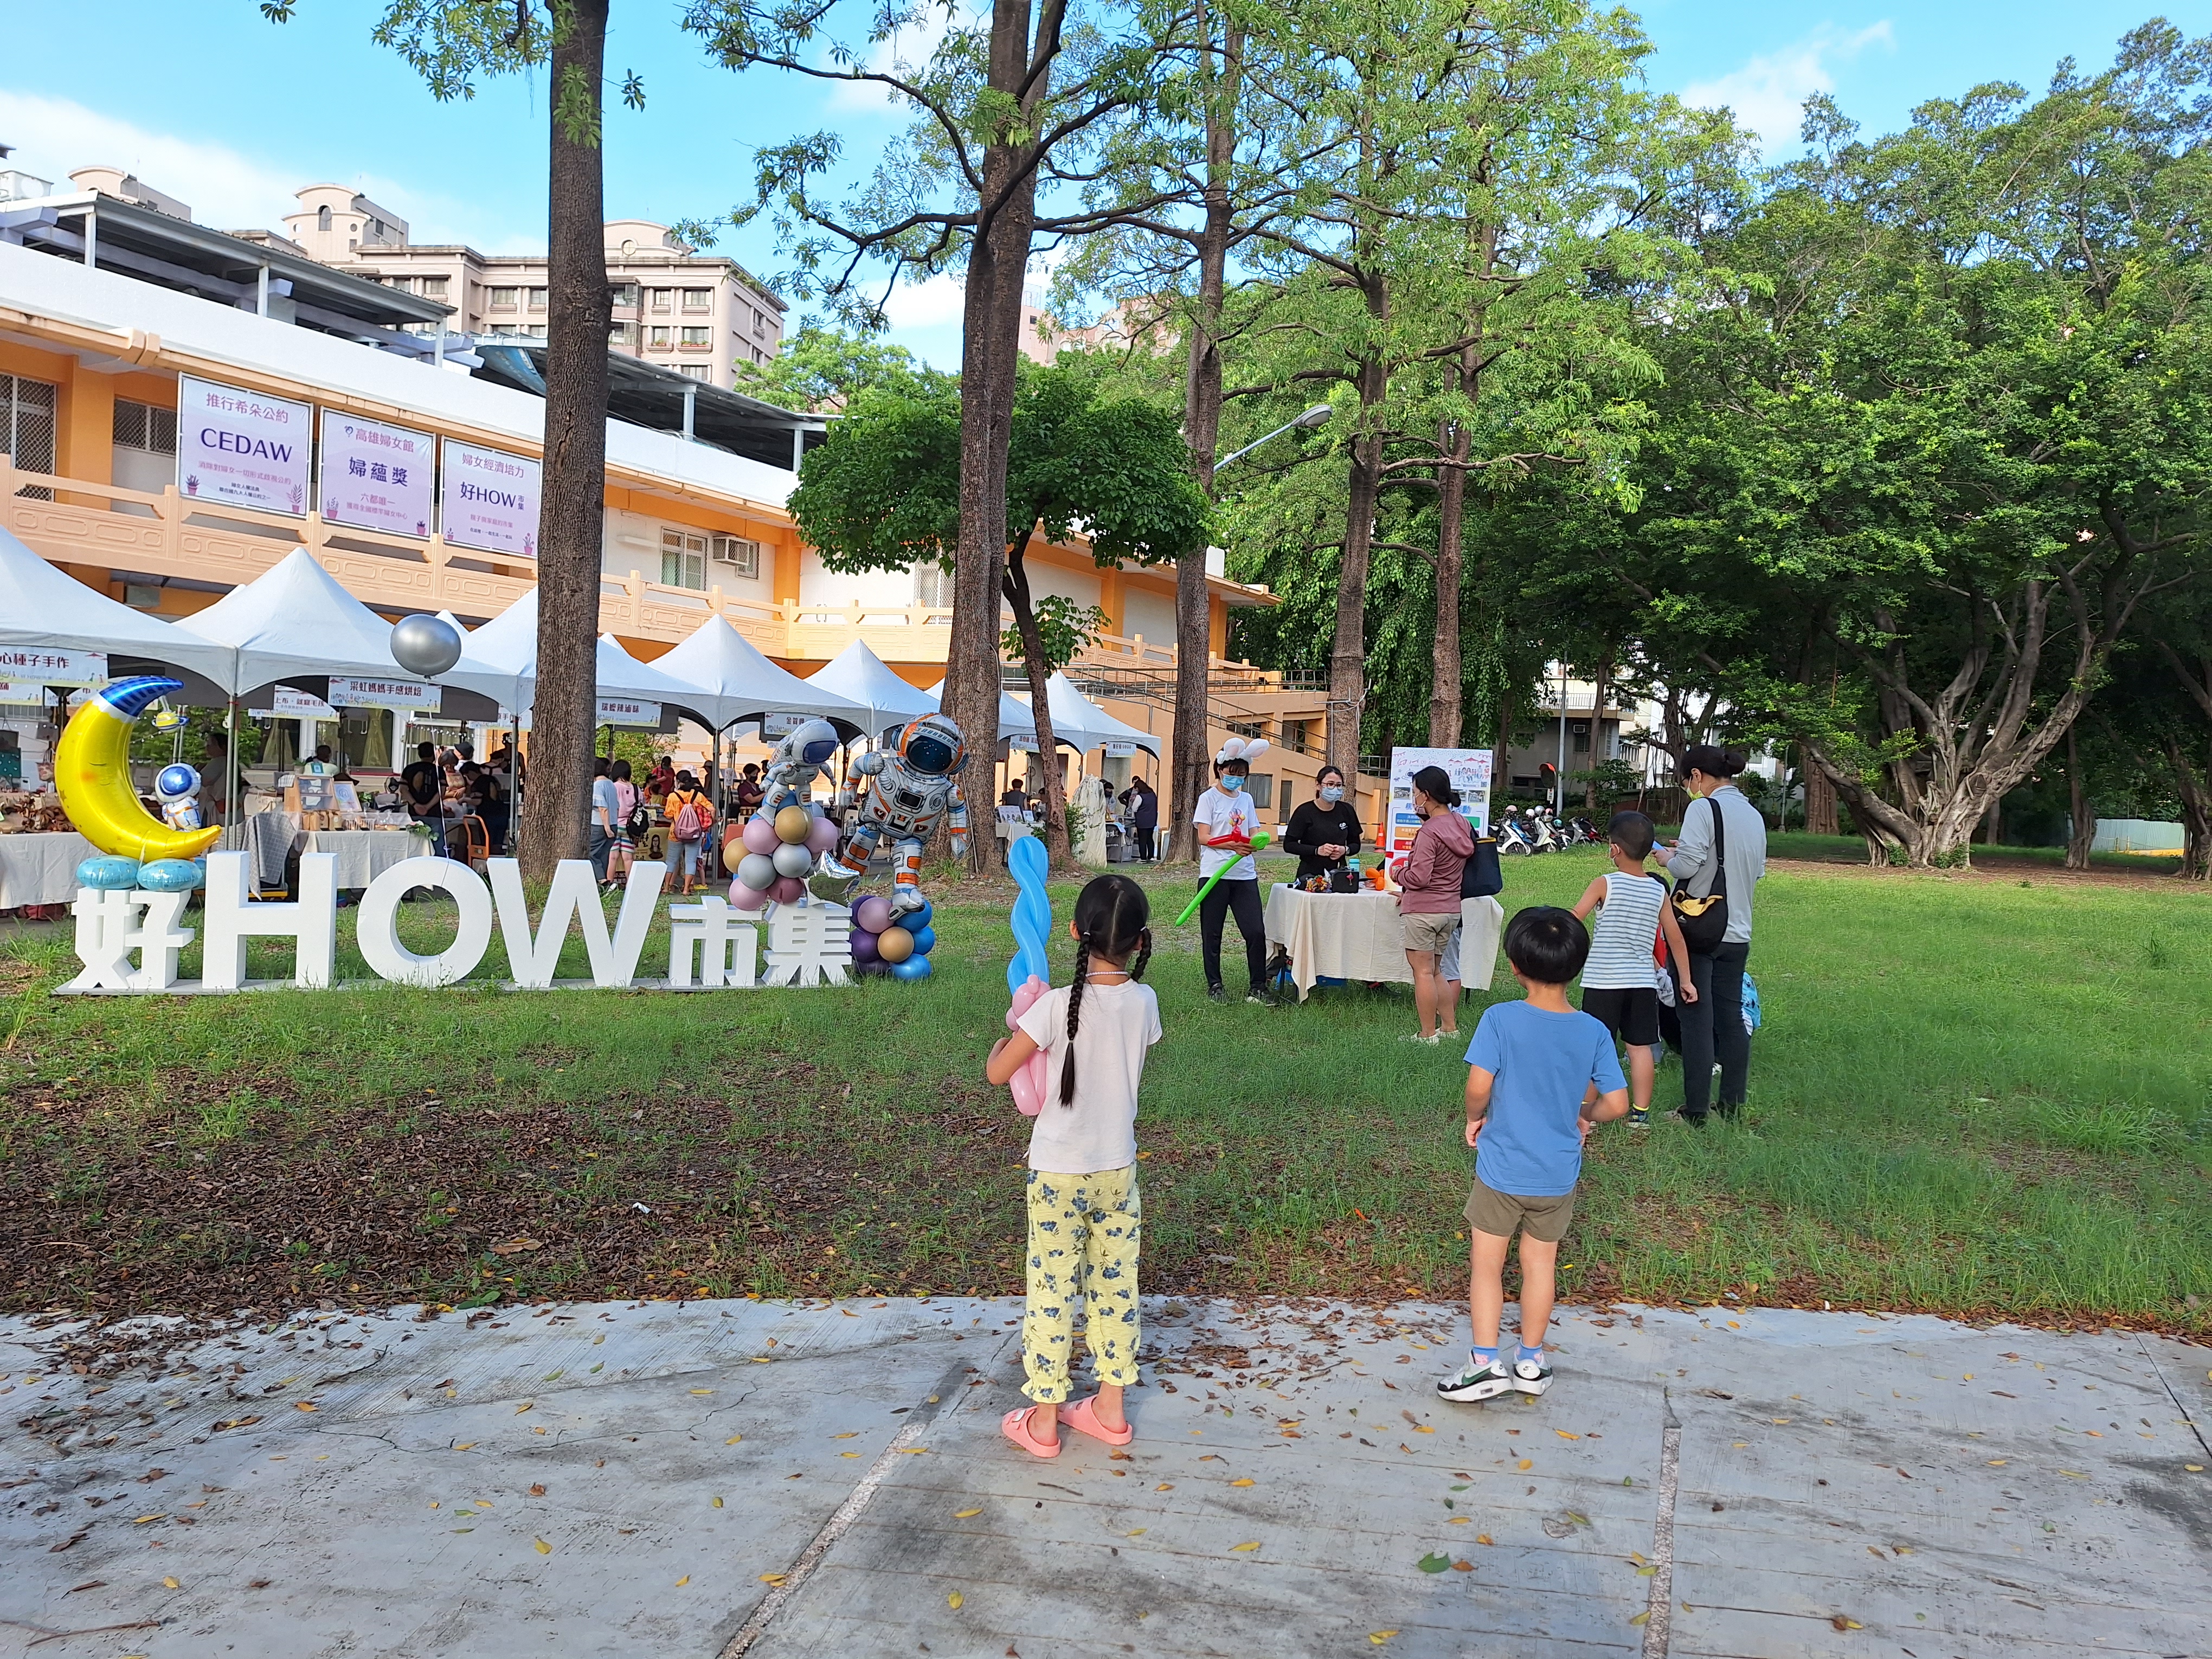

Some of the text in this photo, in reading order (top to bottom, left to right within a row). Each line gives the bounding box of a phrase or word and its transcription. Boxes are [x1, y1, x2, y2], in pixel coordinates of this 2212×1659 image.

[205, 392, 288, 424] 推行希朵公約
[200, 428, 293, 463] CEDAW
[355, 428, 414, 453] 高雄婦女館
[348, 456, 408, 487] 婦蘊獎
[462, 452, 524, 478] 婦女經濟培力
[460, 481, 517, 508] 好HOW
